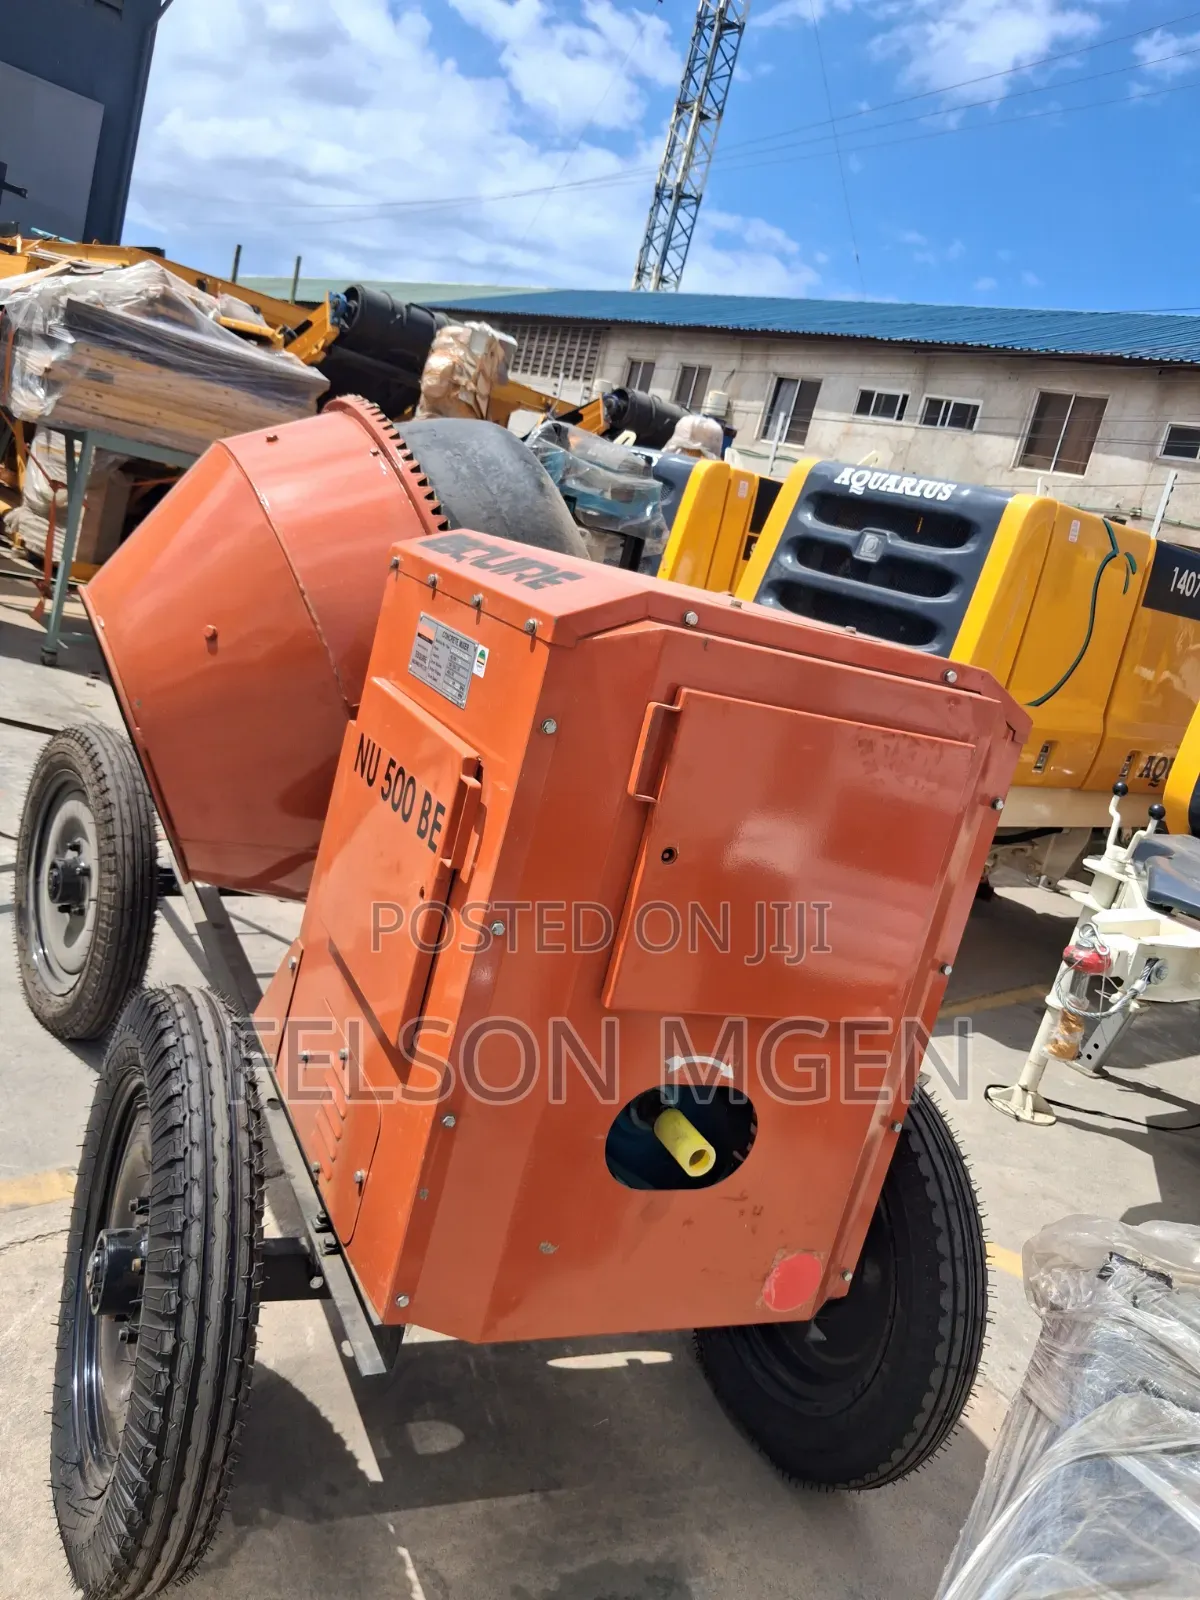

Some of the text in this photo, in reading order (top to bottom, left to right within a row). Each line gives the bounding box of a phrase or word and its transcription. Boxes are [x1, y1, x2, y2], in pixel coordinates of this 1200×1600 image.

[834, 467, 957, 501] AQUARIUS
[354, 732, 446, 854] NU 500 BE
